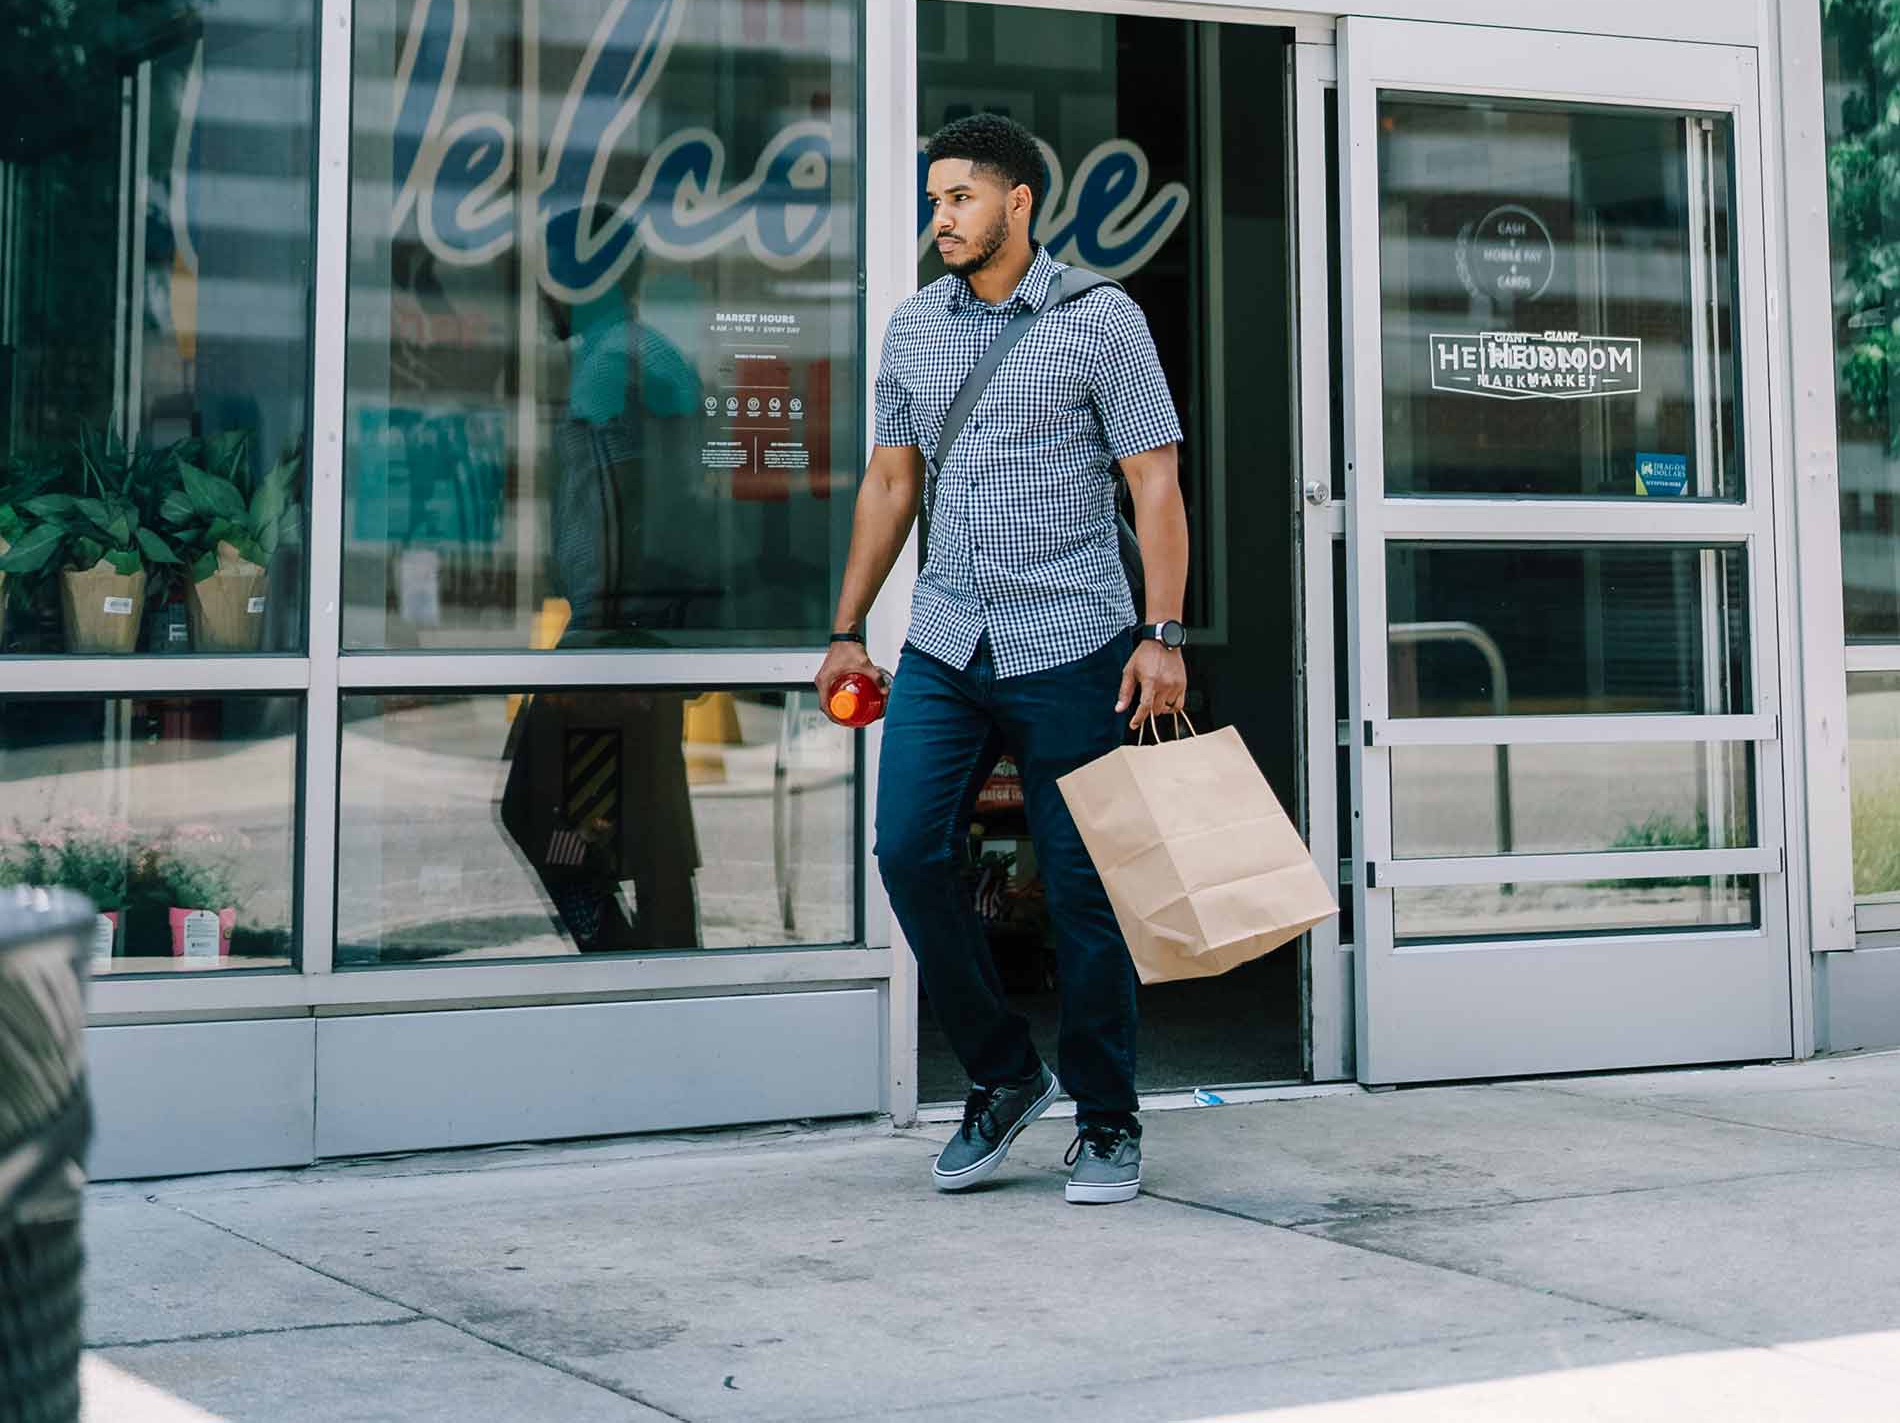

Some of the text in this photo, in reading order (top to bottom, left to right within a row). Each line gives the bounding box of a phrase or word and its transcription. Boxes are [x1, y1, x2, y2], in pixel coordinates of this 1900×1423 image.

[716, 313, 796, 324] MARKET HOURS
[1543, 330, 1579, 343] GIANT
